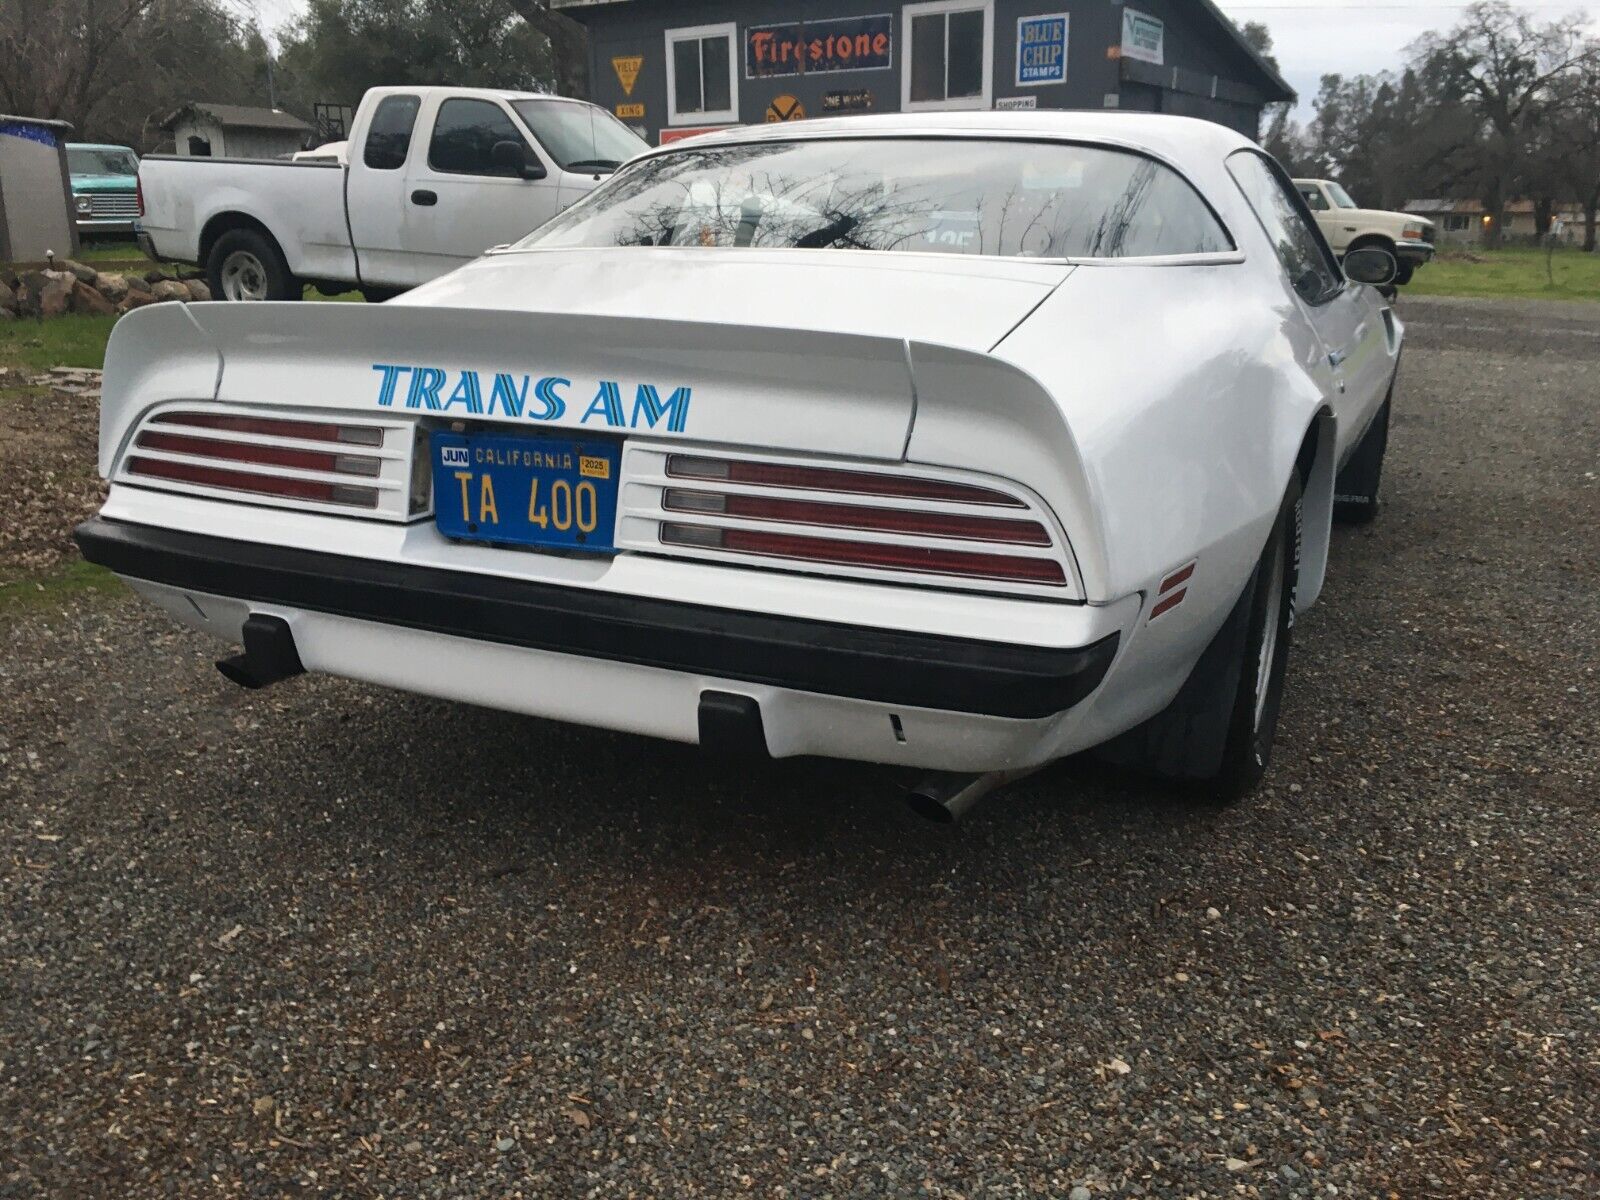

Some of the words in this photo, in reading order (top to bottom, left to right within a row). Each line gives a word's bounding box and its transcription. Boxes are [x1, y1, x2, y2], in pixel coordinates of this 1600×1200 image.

[1024, 22, 1062, 43] BLUE
[751, 31, 887, 63] Firestone
[1022, 45, 1061, 66] CHIP
[616, 61, 638, 73] YIELD
[1023, 66, 1060, 78] STAMPS
[621, 105, 640, 116] XING
[998, 100, 1035, 109] SHOPPING
[372, 364, 570, 421] TRANS
[581, 381, 692, 432] AM
[443, 449, 469, 464] JUN
[476, 448, 573, 469] CALIFORNIA
[585, 460, 604, 470] 2025
[454, 472, 498, 524] TA
[527, 478, 597, 533] 400
